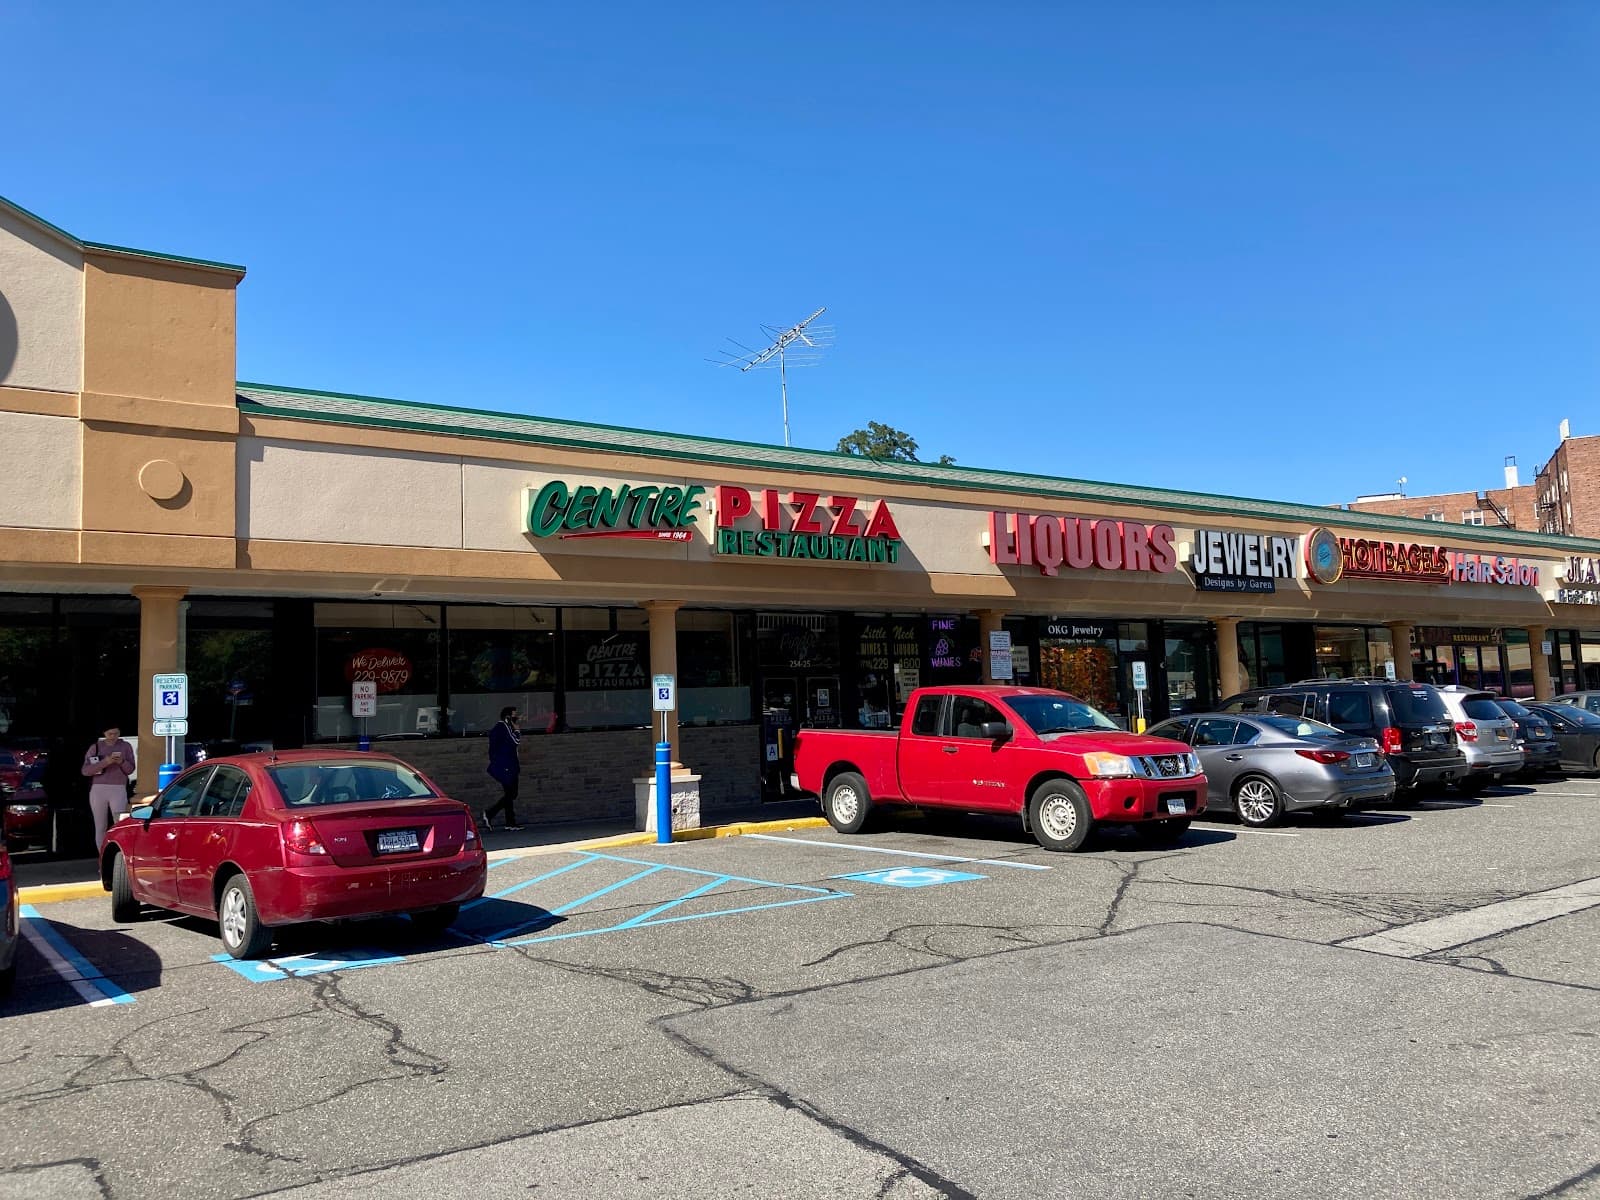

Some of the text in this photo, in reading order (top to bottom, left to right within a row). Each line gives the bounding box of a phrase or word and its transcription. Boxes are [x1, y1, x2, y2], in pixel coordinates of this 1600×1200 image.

[527, 480, 705, 538] CENTRE
[715, 485, 901, 539] PIZZA
[672, 531, 687, 540] 1964
[717, 529, 900, 564] RESTAURANT
[989, 510, 1177, 577] LIQUORS
[1193, 529, 1299, 578] JEWELRY
[1340, 537, 1450, 576] HOT BAGELS
[1492, 555, 1540, 587] Salon
[1204, 576, 1273, 590] Designs by Garen
[932, 619, 955, 630] FINE
[1047, 624, 1104, 637] OKG Jewelry
[587, 642, 638, 662] CENTRE
[352, 655, 406, 670] We Deliver
[931, 656, 961, 668] WINES
[354, 670, 408, 683] 229-9879
[578, 663, 645, 678] PIZZA
[578, 678, 645, 688] RESTAURANT
